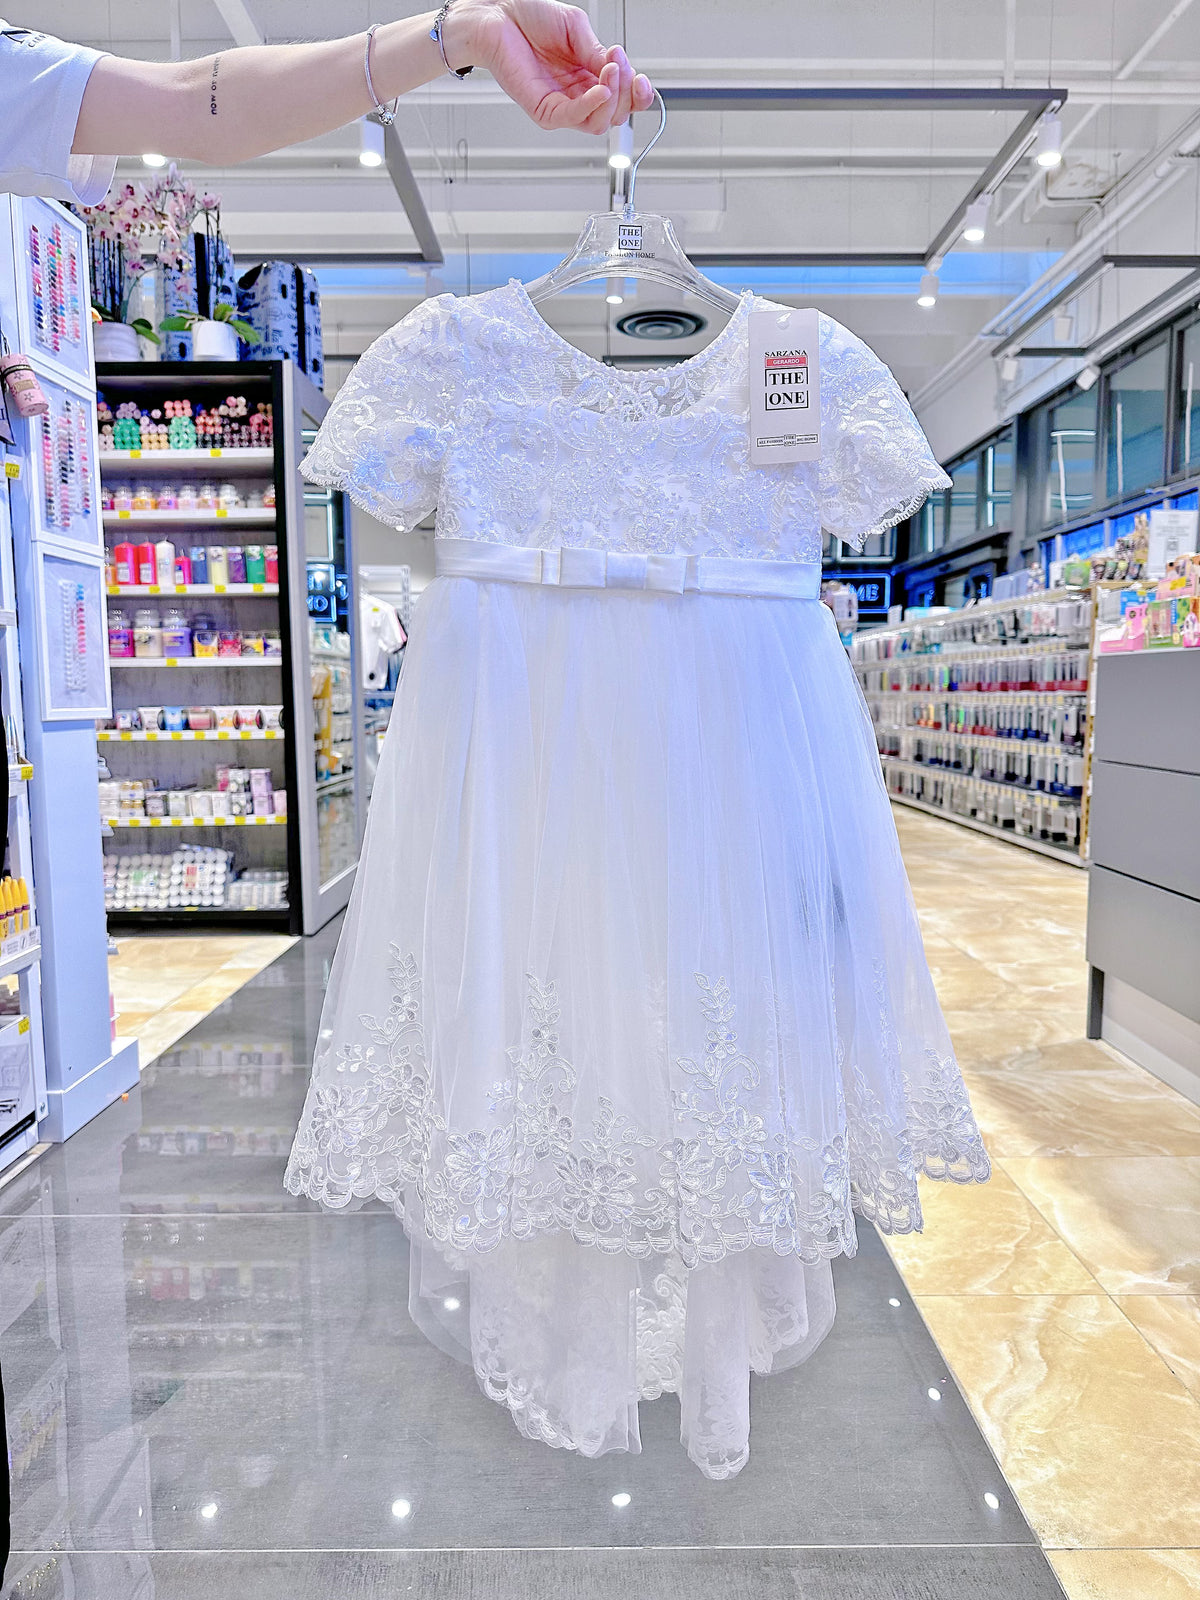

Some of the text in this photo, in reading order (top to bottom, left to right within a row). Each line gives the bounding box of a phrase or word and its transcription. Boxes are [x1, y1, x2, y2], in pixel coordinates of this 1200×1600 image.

[621, 228, 640, 237] THE
[621, 239, 640, 247] ONE
[769, 372, 805, 385] THE
[769, 392, 806, 405] ONE
[849, 584, 879, 601] ME
